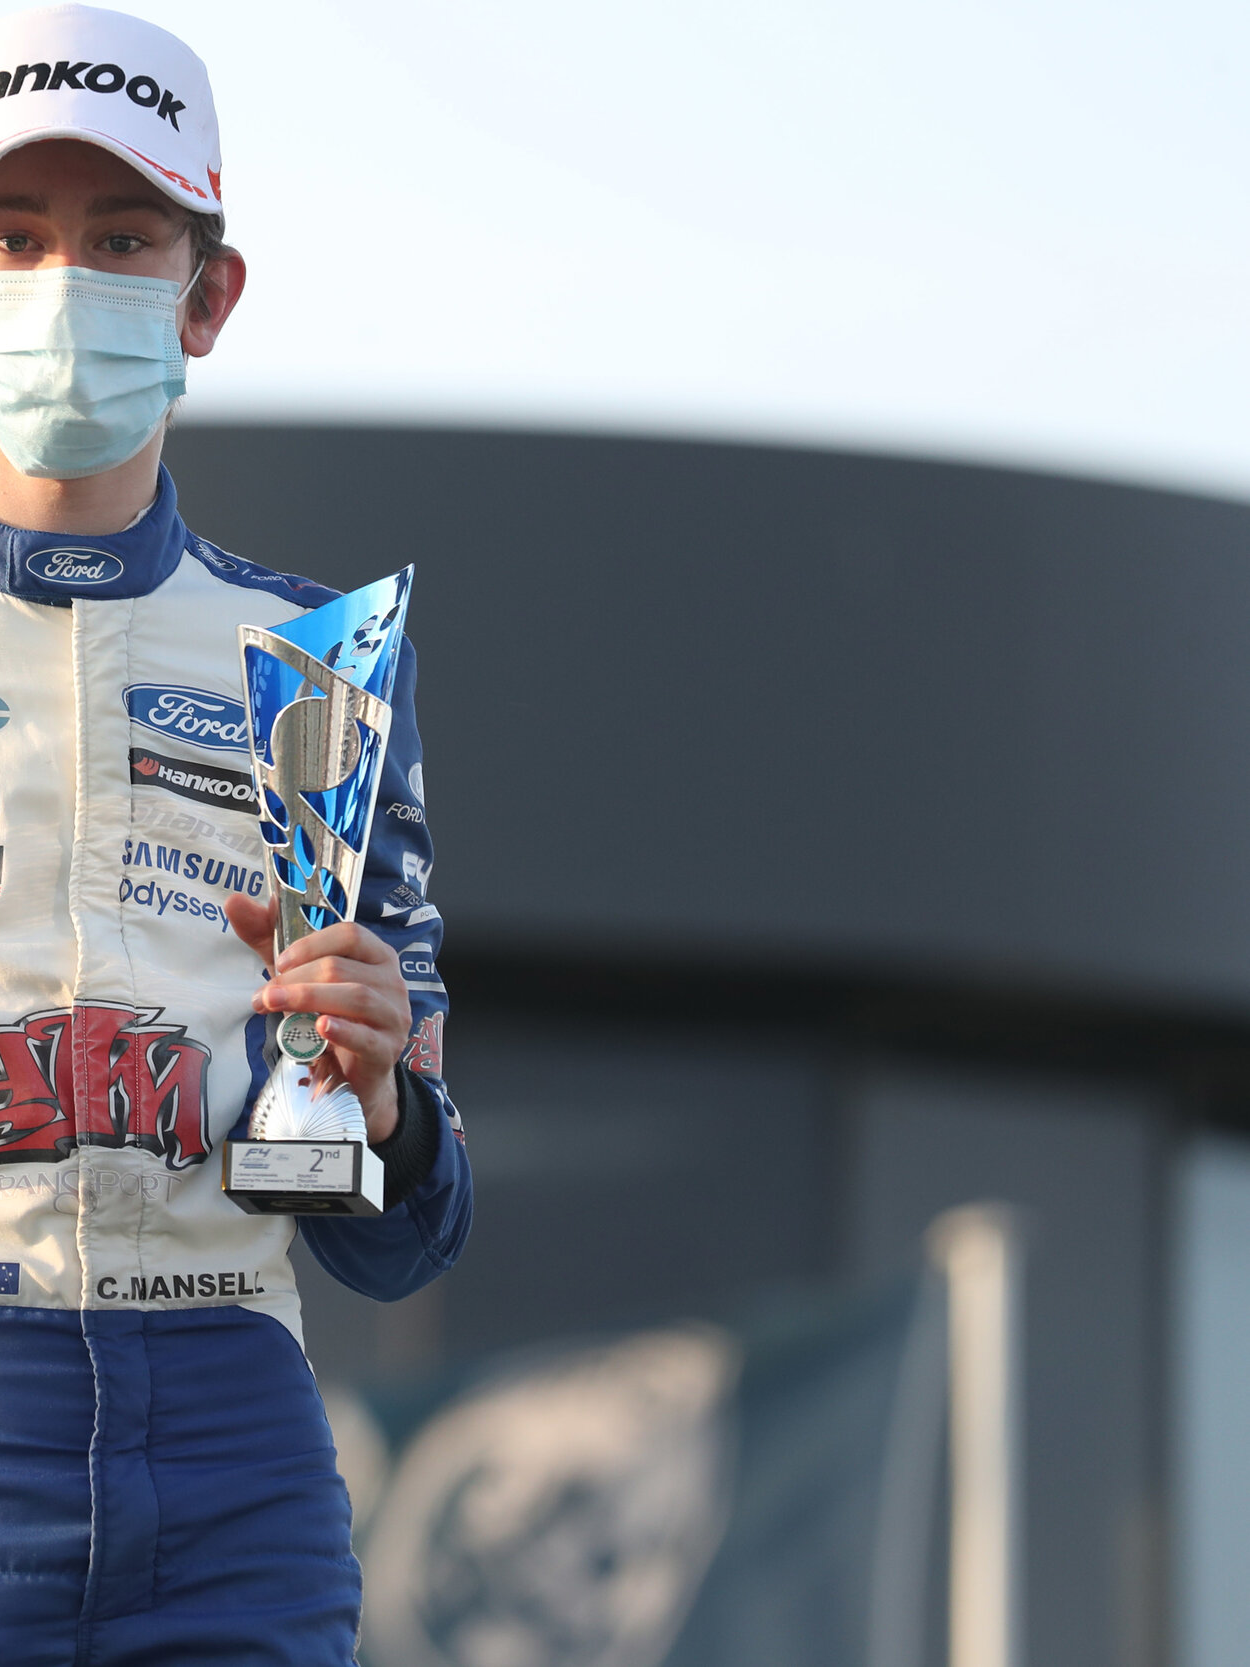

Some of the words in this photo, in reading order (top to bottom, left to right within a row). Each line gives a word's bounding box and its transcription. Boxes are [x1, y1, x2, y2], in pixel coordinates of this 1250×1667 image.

[43, 552, 105, 580] Ford
[148, 693, 248, 743] Ford
[386, 802, 425, 824] FORD
[122, 838, 265, 897] SAMSUNG
[245, 1147, 272, 1158] F4
[309, 1148, 341, 1173] 2nd
